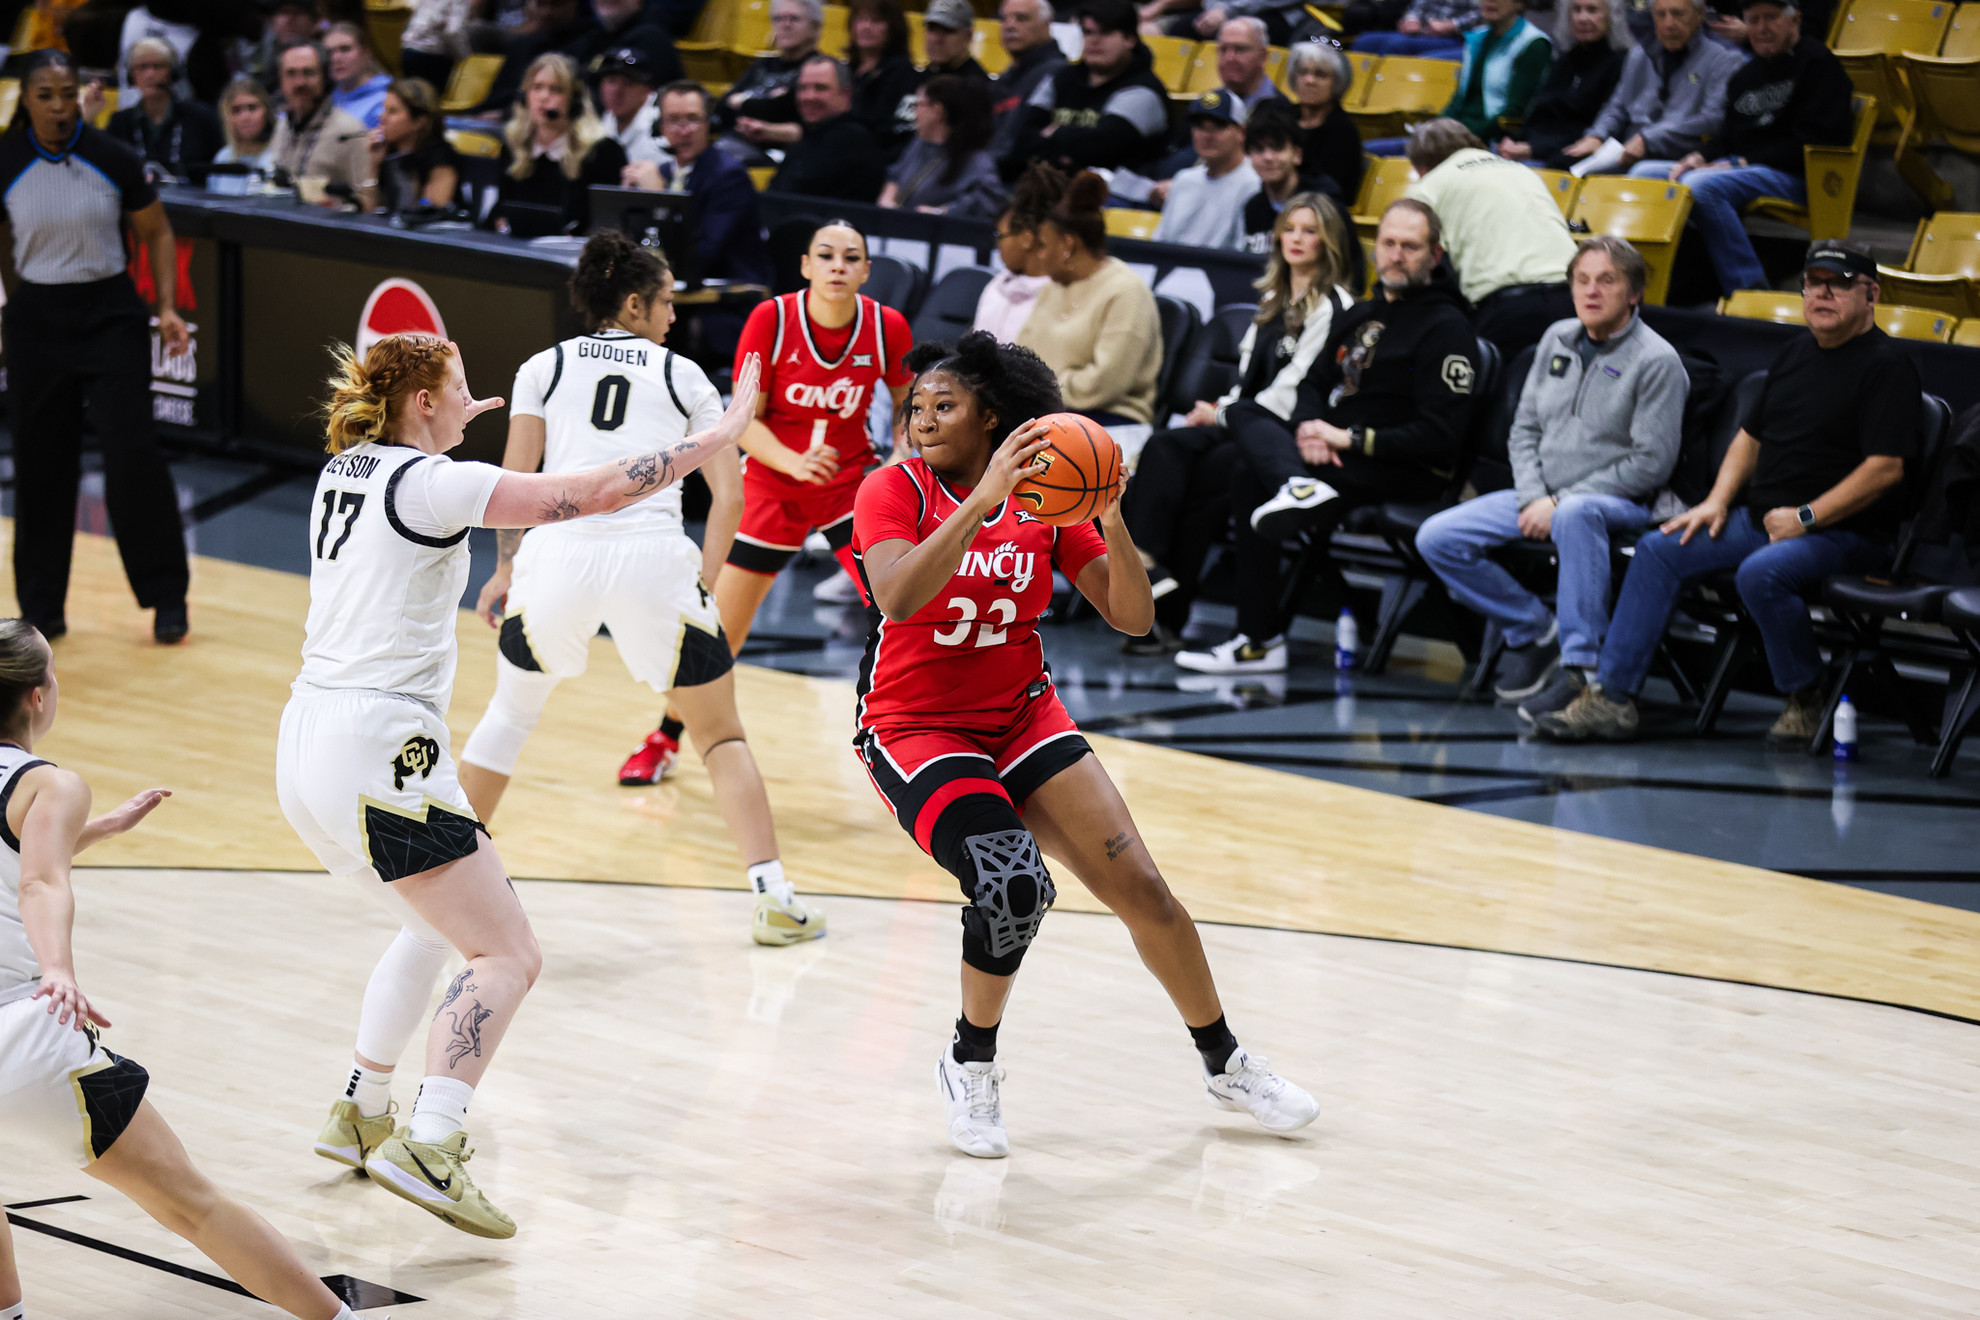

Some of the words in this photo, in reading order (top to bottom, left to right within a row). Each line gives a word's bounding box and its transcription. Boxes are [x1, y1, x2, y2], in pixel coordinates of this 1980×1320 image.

[578, 341, 648, 367] GOODEN
[590, 374, 632, 432] 0
[785, 377, 865, 419] CINCY
[316, 487, 367, 563] 17
[954, 541, 1035, 593] INCY
[933, 596, 1017, 648] 32
